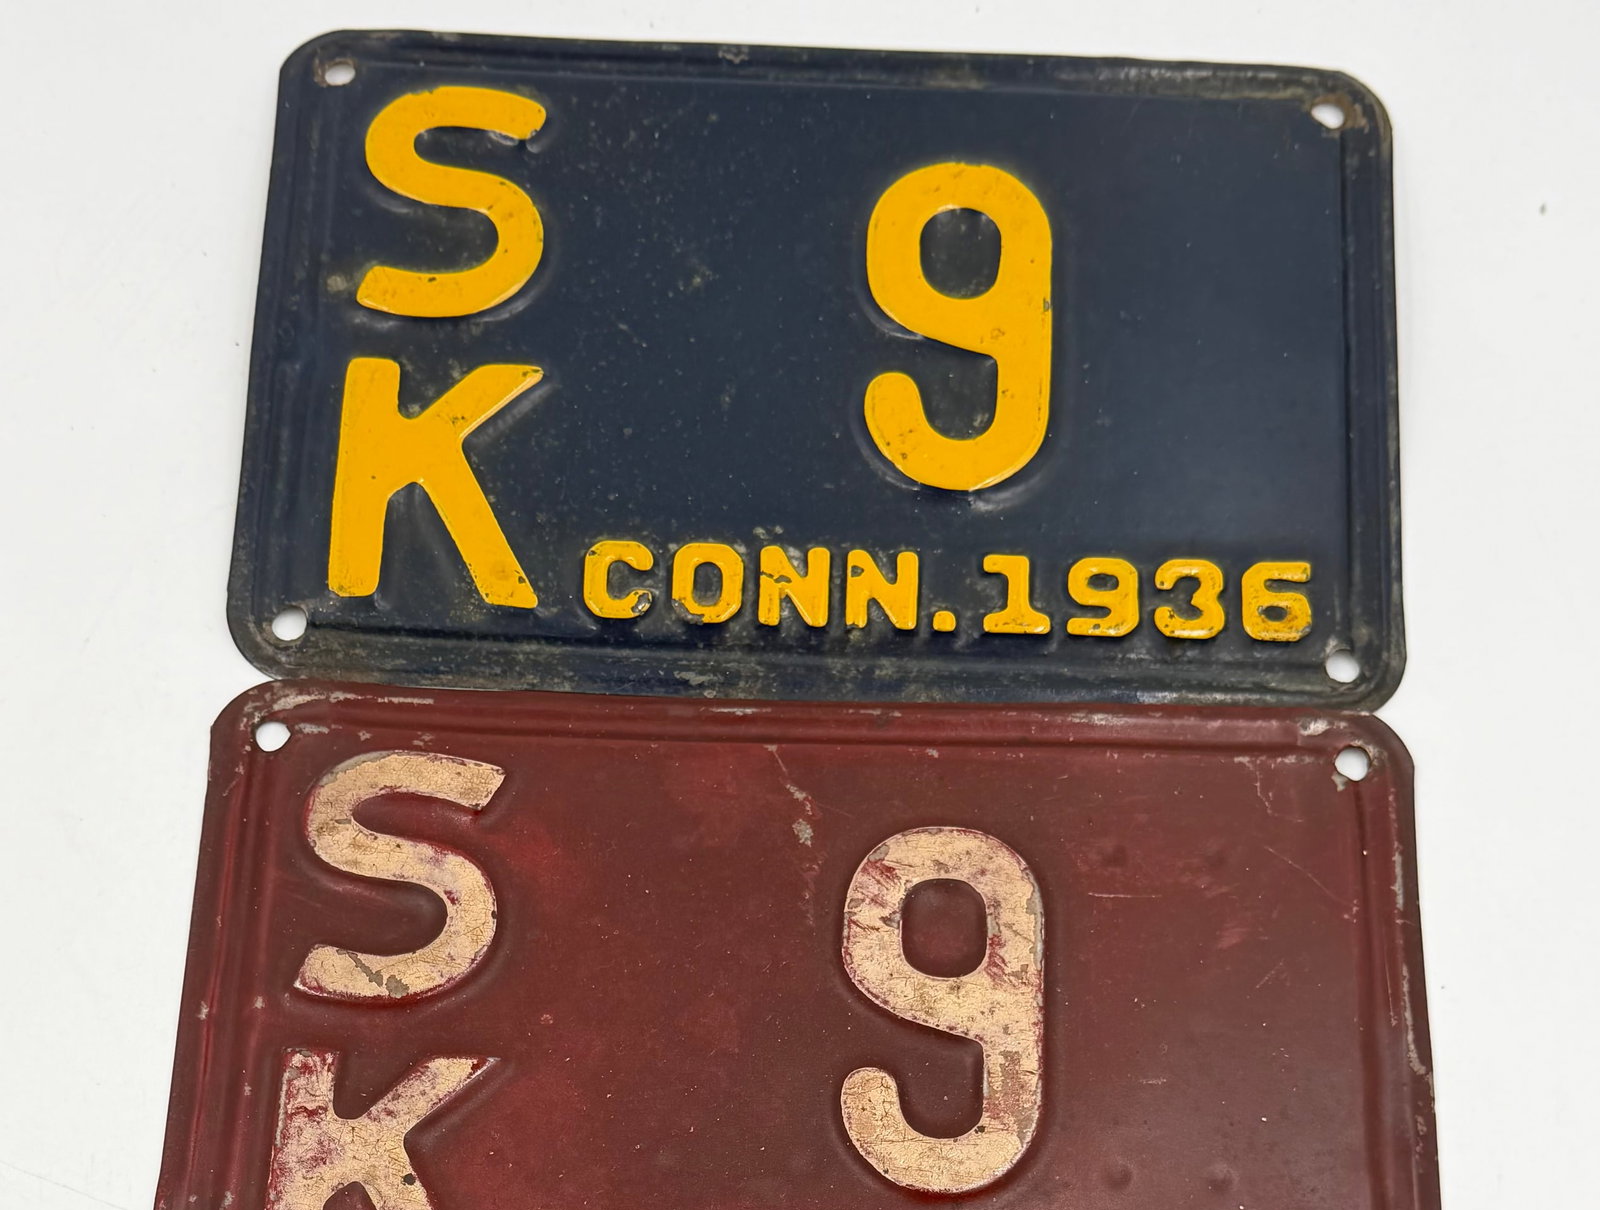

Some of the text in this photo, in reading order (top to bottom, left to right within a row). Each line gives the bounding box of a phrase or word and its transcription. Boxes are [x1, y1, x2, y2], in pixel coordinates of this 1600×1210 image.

[355, 84, 548, 319] S
[864, 161, 1053, 491] 9
[327, 356, 545, 610] K
[293, 750, 507, 1001] S
[840, 825, 1046, 1195] 9
